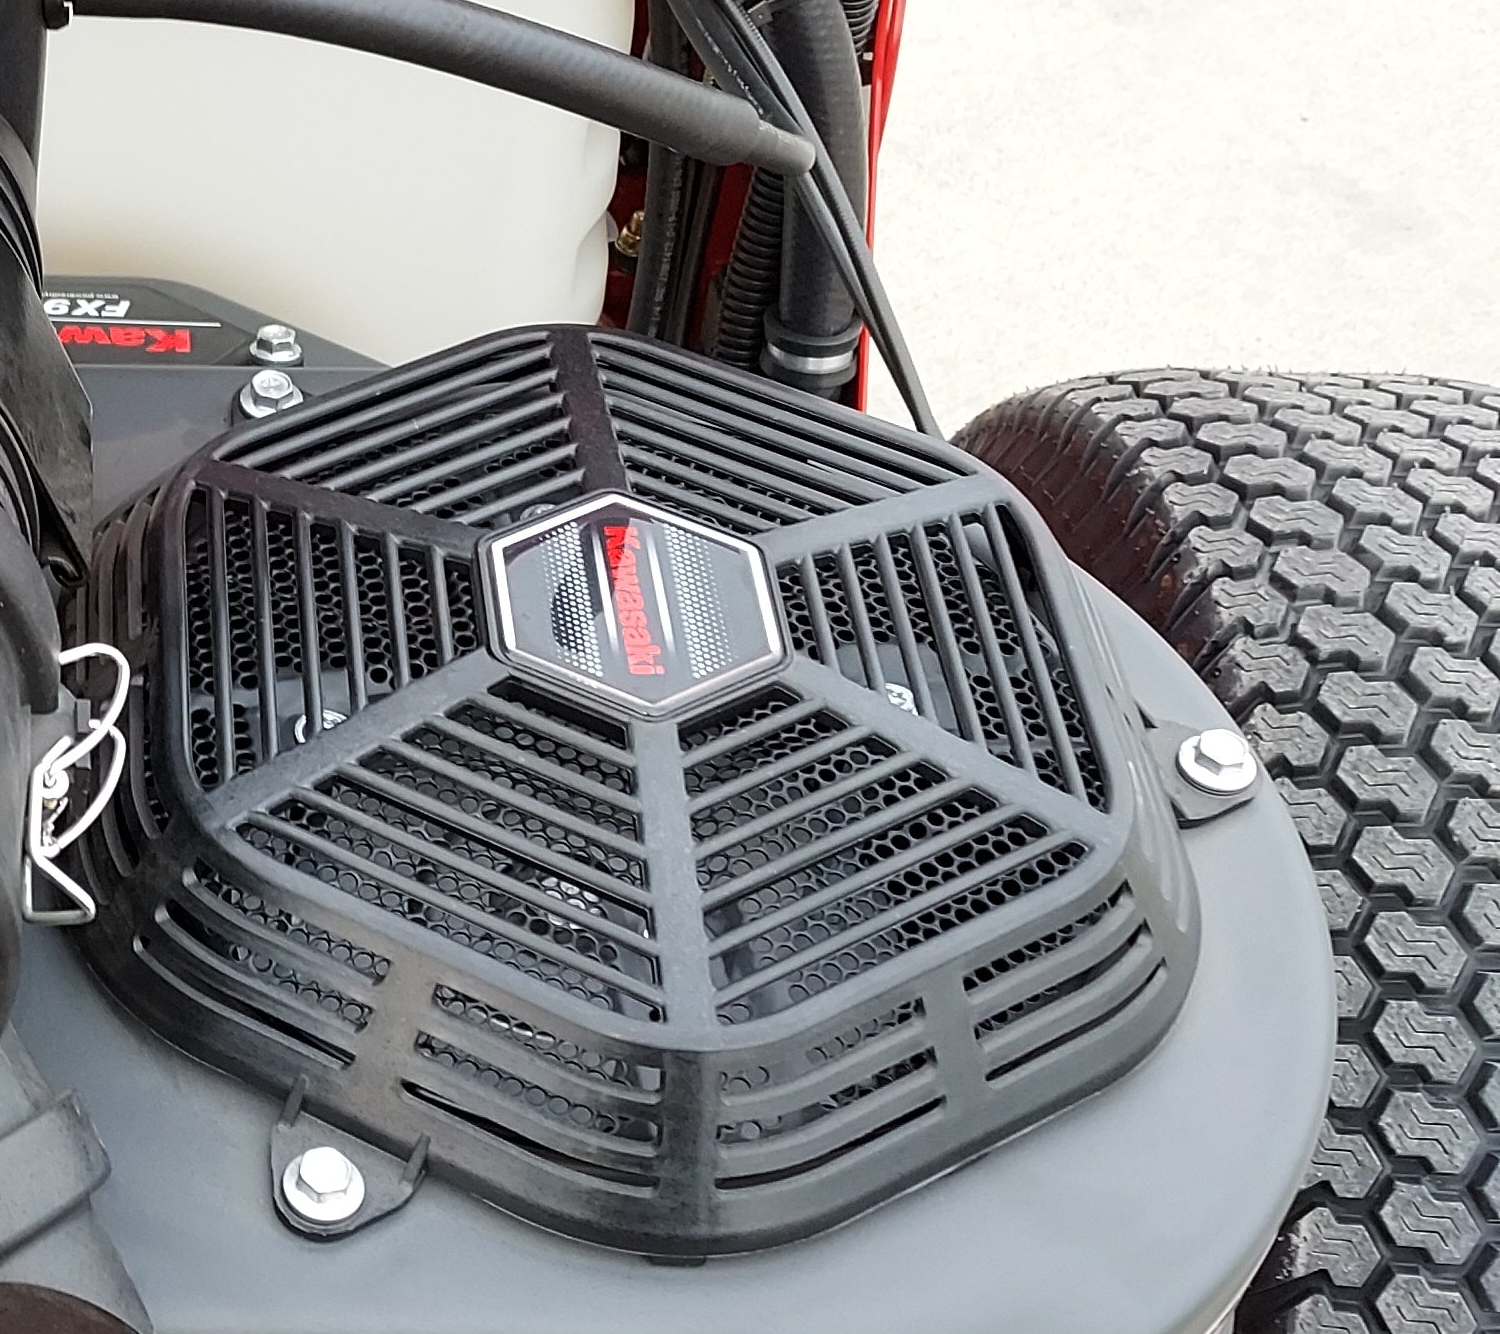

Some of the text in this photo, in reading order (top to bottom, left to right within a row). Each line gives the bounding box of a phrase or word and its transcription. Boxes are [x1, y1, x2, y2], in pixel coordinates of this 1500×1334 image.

[43, 298, 131, 317] FX9
[55, 324, 191, 353] Kaw
[603, 526, 665, 675] Kawasaki
